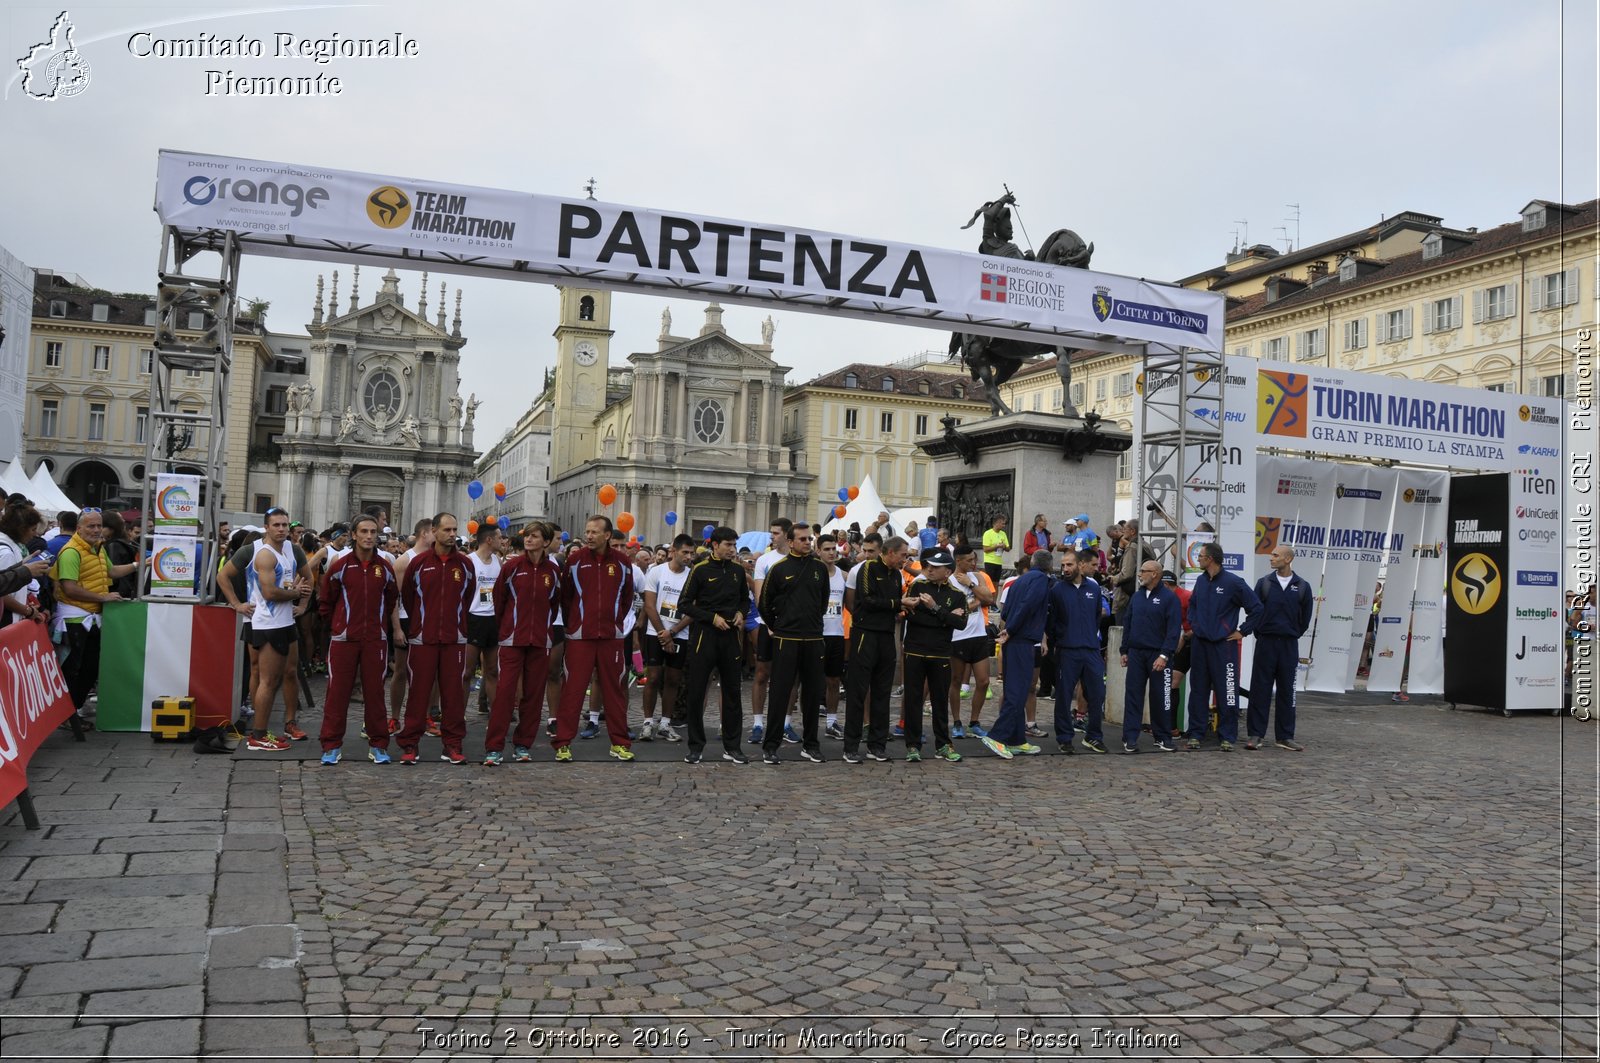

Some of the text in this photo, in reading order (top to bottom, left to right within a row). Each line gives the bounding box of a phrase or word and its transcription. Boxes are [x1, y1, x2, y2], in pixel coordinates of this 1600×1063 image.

[188, 160, 334, 181] partner in comunicazione
[415, 191, 467, 215] TEAM
[216, 218, 290, 232] www.orange.srl
[411, 211, 516, 241] MARATHON
[436, 235, 461, 243] your
[468, 238, 513, 249] passion
[557, 202, 939, 304] PARTENZA
[982, 260, 1055, 279] Con il patrocinio di:
[1008, 278, 1065, 299] REGIONE
[1008, 292, 1065, 312] PIEMONTE
[1153, 311, 1164, 322] DI
[1166, 310, 1205, 329] TORINO
[1313, 385, 1505, 439] TURIN MARATHON
[1531, 406, 1546, 415] TEAM
[1531, 415, 1560, 425] MARATHON
[1312, 426, 1505, 460] GRAN PREMIO LA STAMPA
[1531, 446, 1559, 457] KARHU
[1523, 476, 1555, 495] iren
[165, 499, 197, 507] BENESSERE
[1525, 507, 1558, 520] UniCredit
[1454, 520, 1479, 532] TEAM
[1453, 530, 1502, 543] MARATHON
[1528, 573, 1553, 582] Bavaria
[1516, 607, 1557, 620] battaglio
[1515, 635, 1557, 660] J medical
